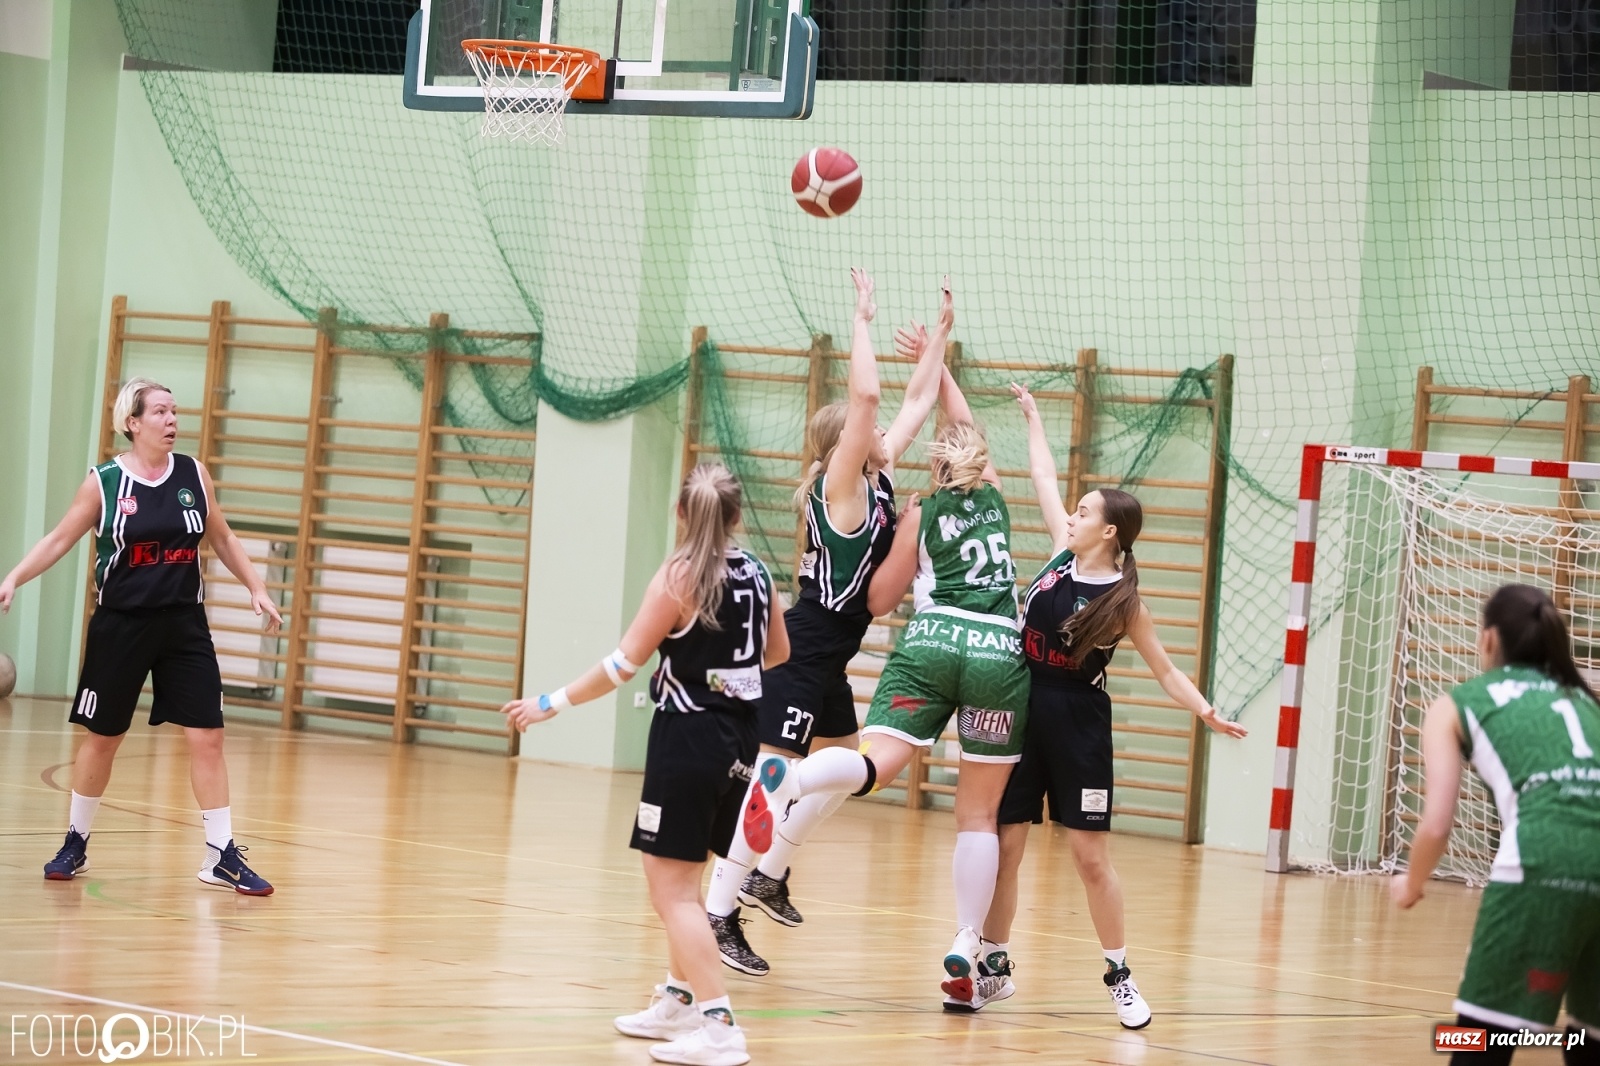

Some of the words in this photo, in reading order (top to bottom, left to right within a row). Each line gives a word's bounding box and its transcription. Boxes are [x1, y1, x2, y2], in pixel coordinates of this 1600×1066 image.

[1354, 452, 1376, 460] sport
[183, 509, 204, 534] 10
[960, 532, 1013, 583] 25
[733, 589, 755, 661] 3
[77, 688, 97, 719] 10
[781, 706, 814, 744] 27
[1550, 699, 1594, 759] 1
